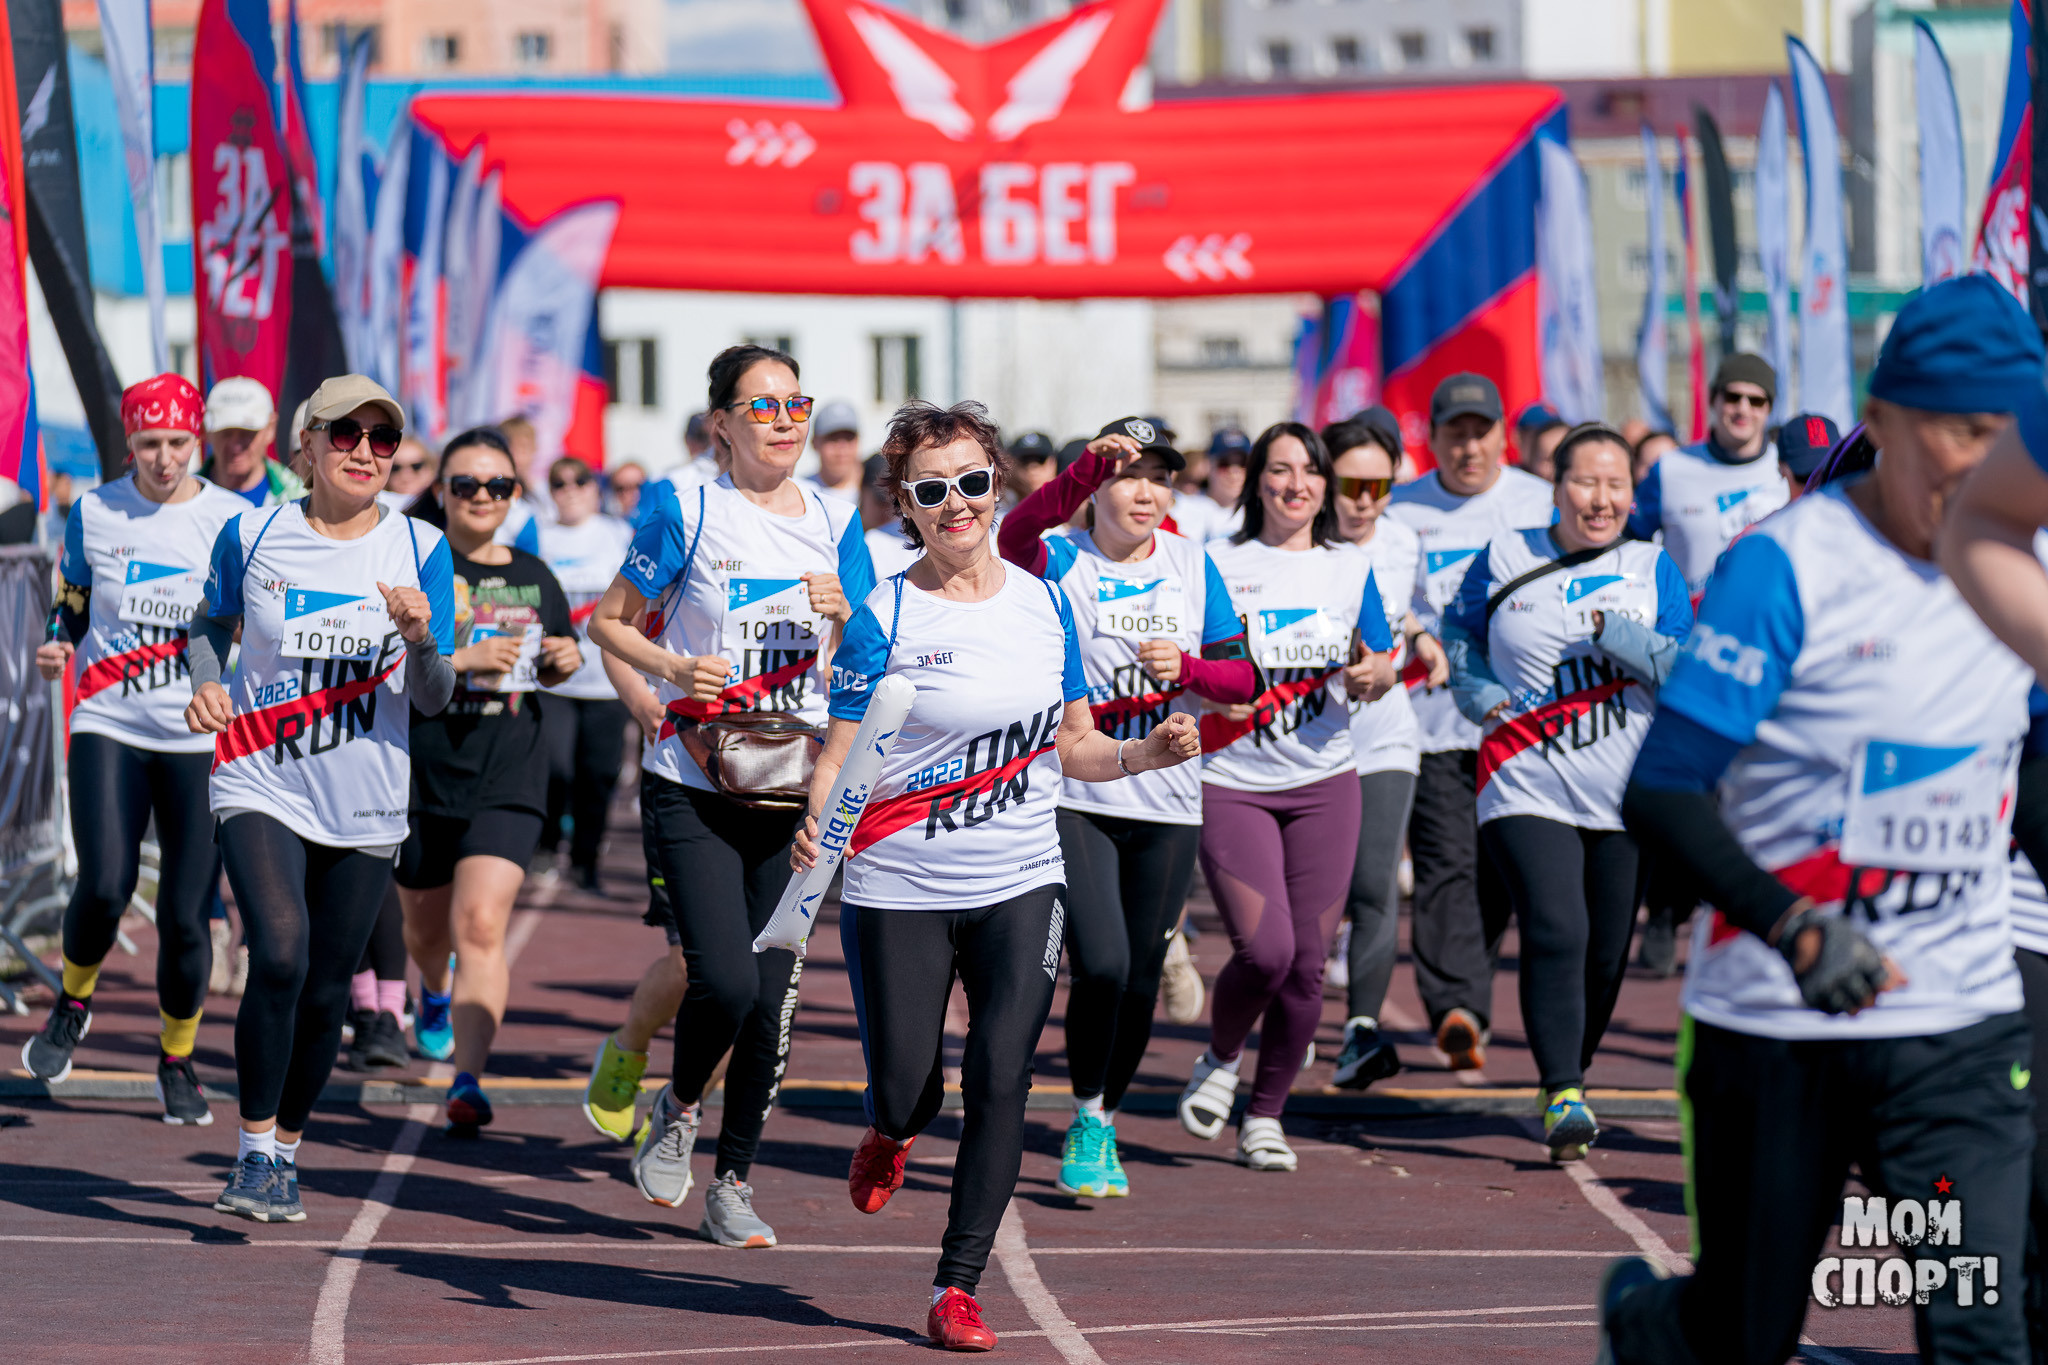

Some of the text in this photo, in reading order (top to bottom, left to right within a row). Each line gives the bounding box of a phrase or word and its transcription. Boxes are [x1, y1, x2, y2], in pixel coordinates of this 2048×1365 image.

[850, 161, 1136, 264] ЗА БЕГ
[726, 560, 743, 571] БЕГ
[296, 594, 306, 607] 5
[739, 583, 749, 596] 5
[129, 596, 194, 623] 10080
[333, 618, 346, 629] БЕГ
[740, 620, 812, 640] 10113
[1108, 614, 1178, 633] 10055
[294, 631, 371, 657] 10108
[1273, 644, 1339, 662] 10040
[917, 651, 954, 668] ЗА БЕГ
[253, 677, 298, 708] 2022
[275, 691, 376, 767] RUN
[907, 699, 1062, 793] 2022 ONE
[925, 764, 1029, 841] RUN
[1880, 815, 1991, 851] 10143
[1019, 857, 1050, 872] #ЗАБЕГРФ
[777, 987, 799, 1057] ANGELES
